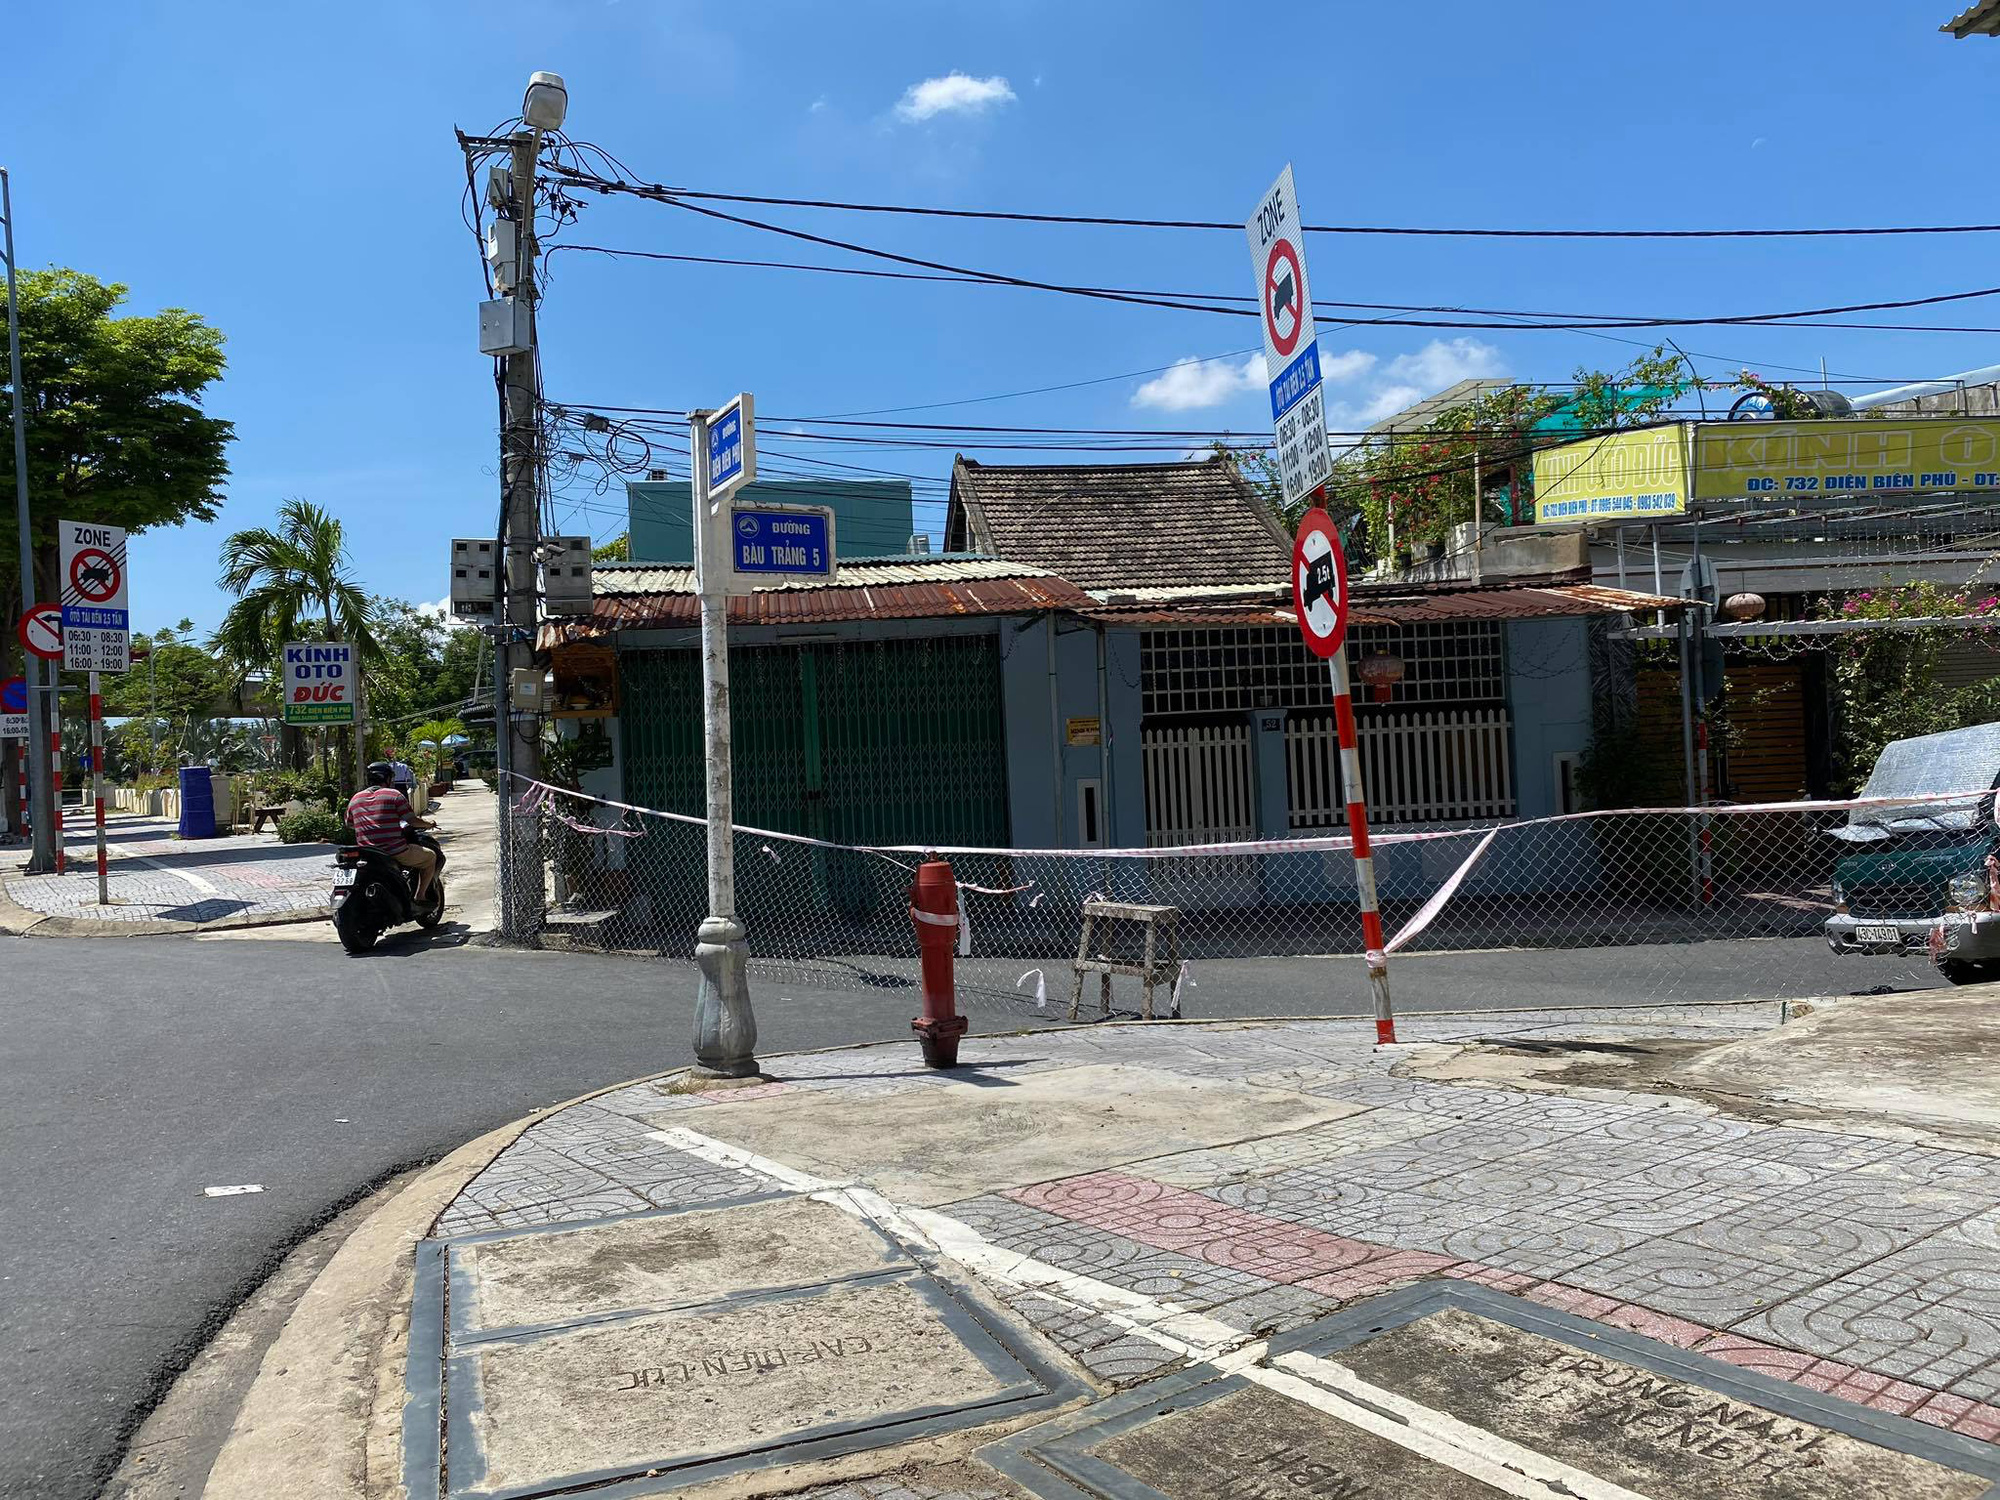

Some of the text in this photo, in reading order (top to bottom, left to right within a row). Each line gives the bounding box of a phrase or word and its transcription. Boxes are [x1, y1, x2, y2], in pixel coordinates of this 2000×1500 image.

[1257, 187, 1285, 246] ZONE
[1279, 415, 1296, 448] 06:30
[1301, 395, 1319, 428] 08:30
[1282, 443, 1299, 474] 11:00
[1304, 424, 1323, 456] 12:00
[1701, 428, 1912, 472] KÍNH
[1286, 470, 1304, 501] 16:00
[1308, 452, 1327, 485] 19:00
[1747, 478, 1778, 491] ĐC:
[1785, 477, 1818, 490] 732
[1825, 474, 1866, 492] ĐIỆN
[1873, 472, 1914, 488] BIÊN
[1920, 470, 1956, 487] PHỦ
[74, 528, 111, 547] ZONE
[772, 520, 811, 535] ĐƯỜNG
[743, 540, 820, 567] BÀU TRẢNG 5
[68, 630, 91, 641] 06:30
[100, 632, 123, 643] 08:30
[69, 643, 91, 655] 11:00
[101, 645, 123, 656] 12:00
[287, 646, 350, 662] KÍNH
[70, 657, 92, 668] 16:00
[101, 658, 123, 669] 19:00
[295, 664, 343, 679] OTO
[293, 681, 345, 702] ĐỨC
[289, 704, 307, 714] 732
